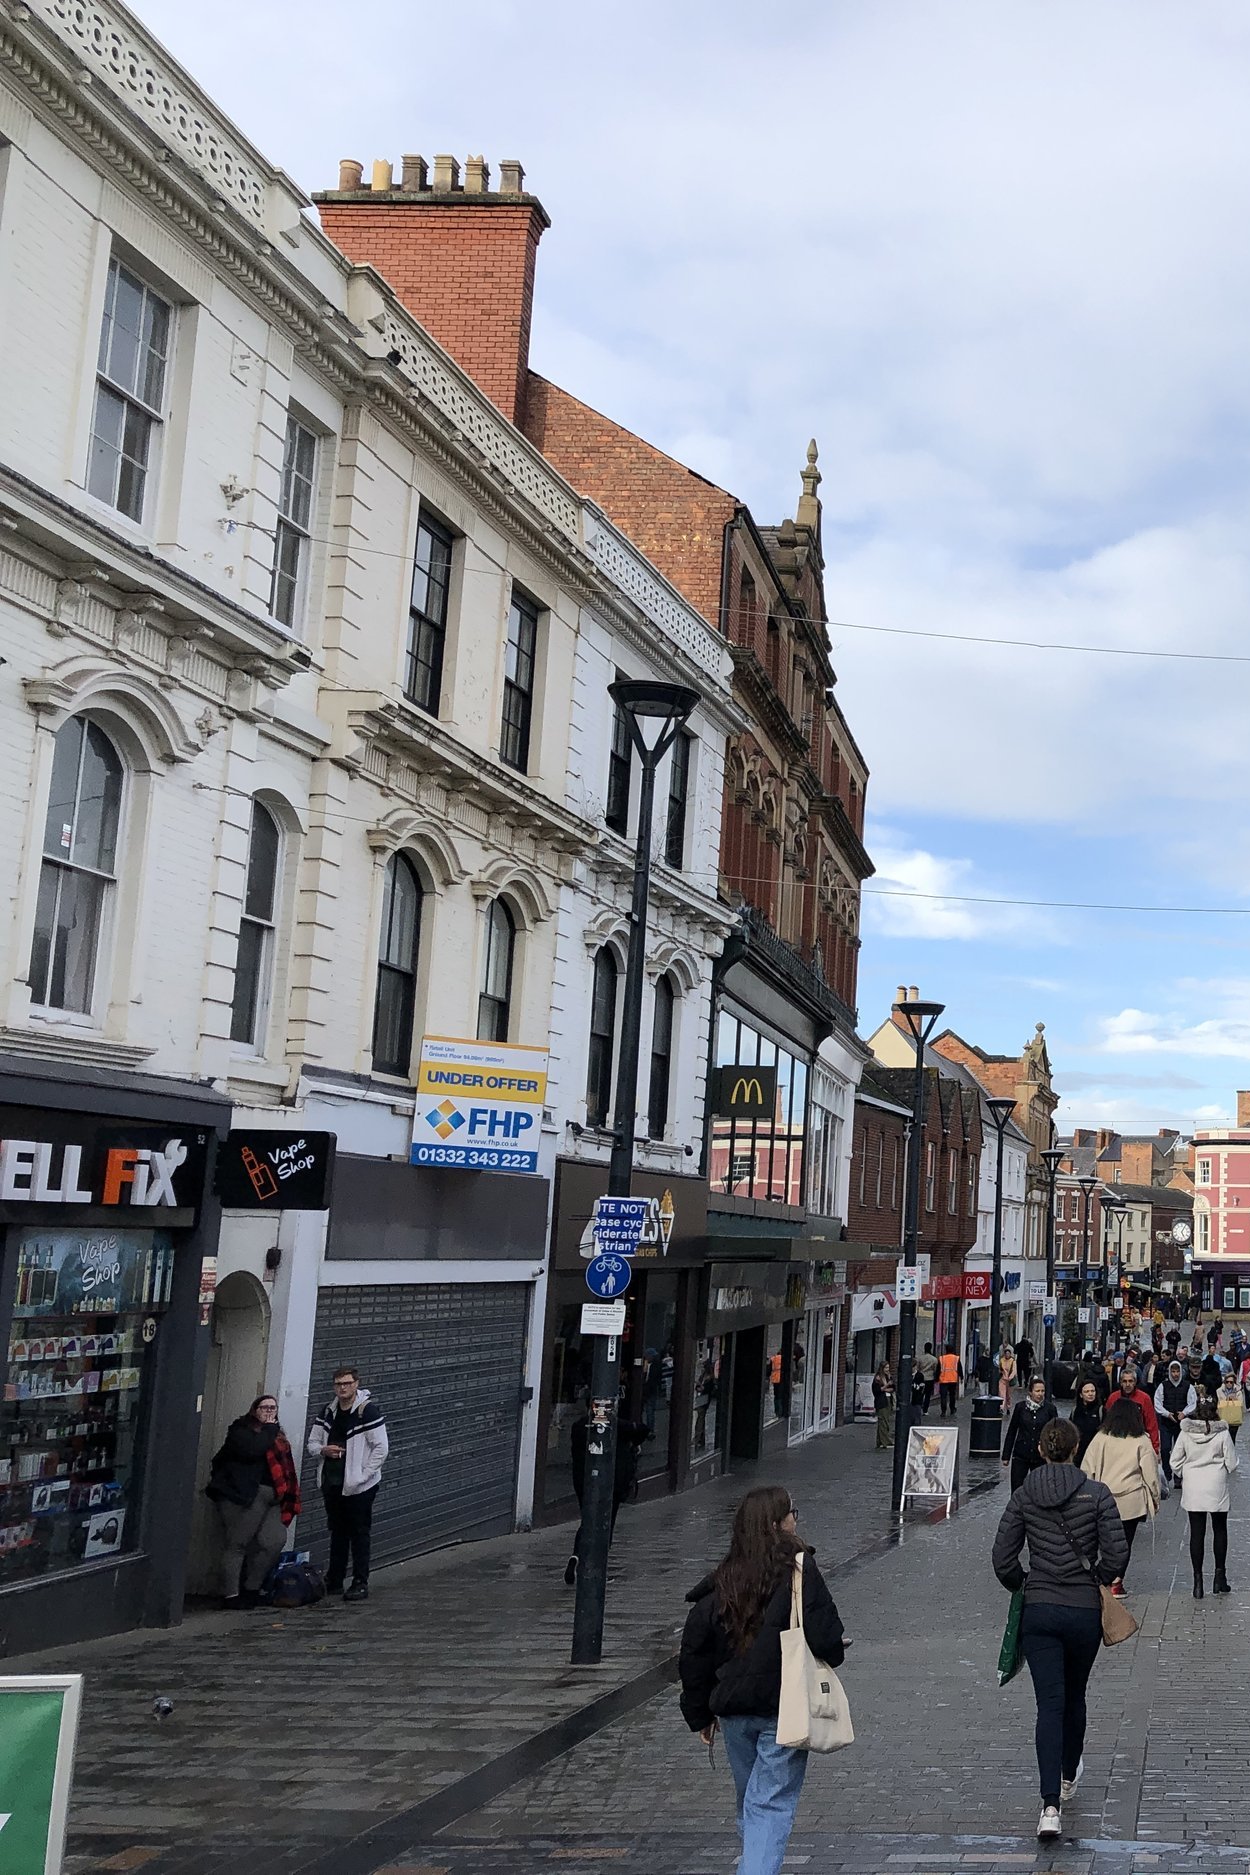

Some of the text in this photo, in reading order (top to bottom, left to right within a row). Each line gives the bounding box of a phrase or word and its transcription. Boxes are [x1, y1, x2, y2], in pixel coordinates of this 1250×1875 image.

[427, 1070, 538, 1092] UNDER OFFER
[468, 1108, 533, 1138] FHP
[268, 1137, 306, 1163] Vape
[467, 1138, 518, 1147] www.fhp.co.uk
[277, 1153, 315, 1180] Shop
[418, 1147, 530, 1168] 01332 343 222
[79, 1234, 117, 1264] Vape
[82, 1258, 120, 1291] Shop
